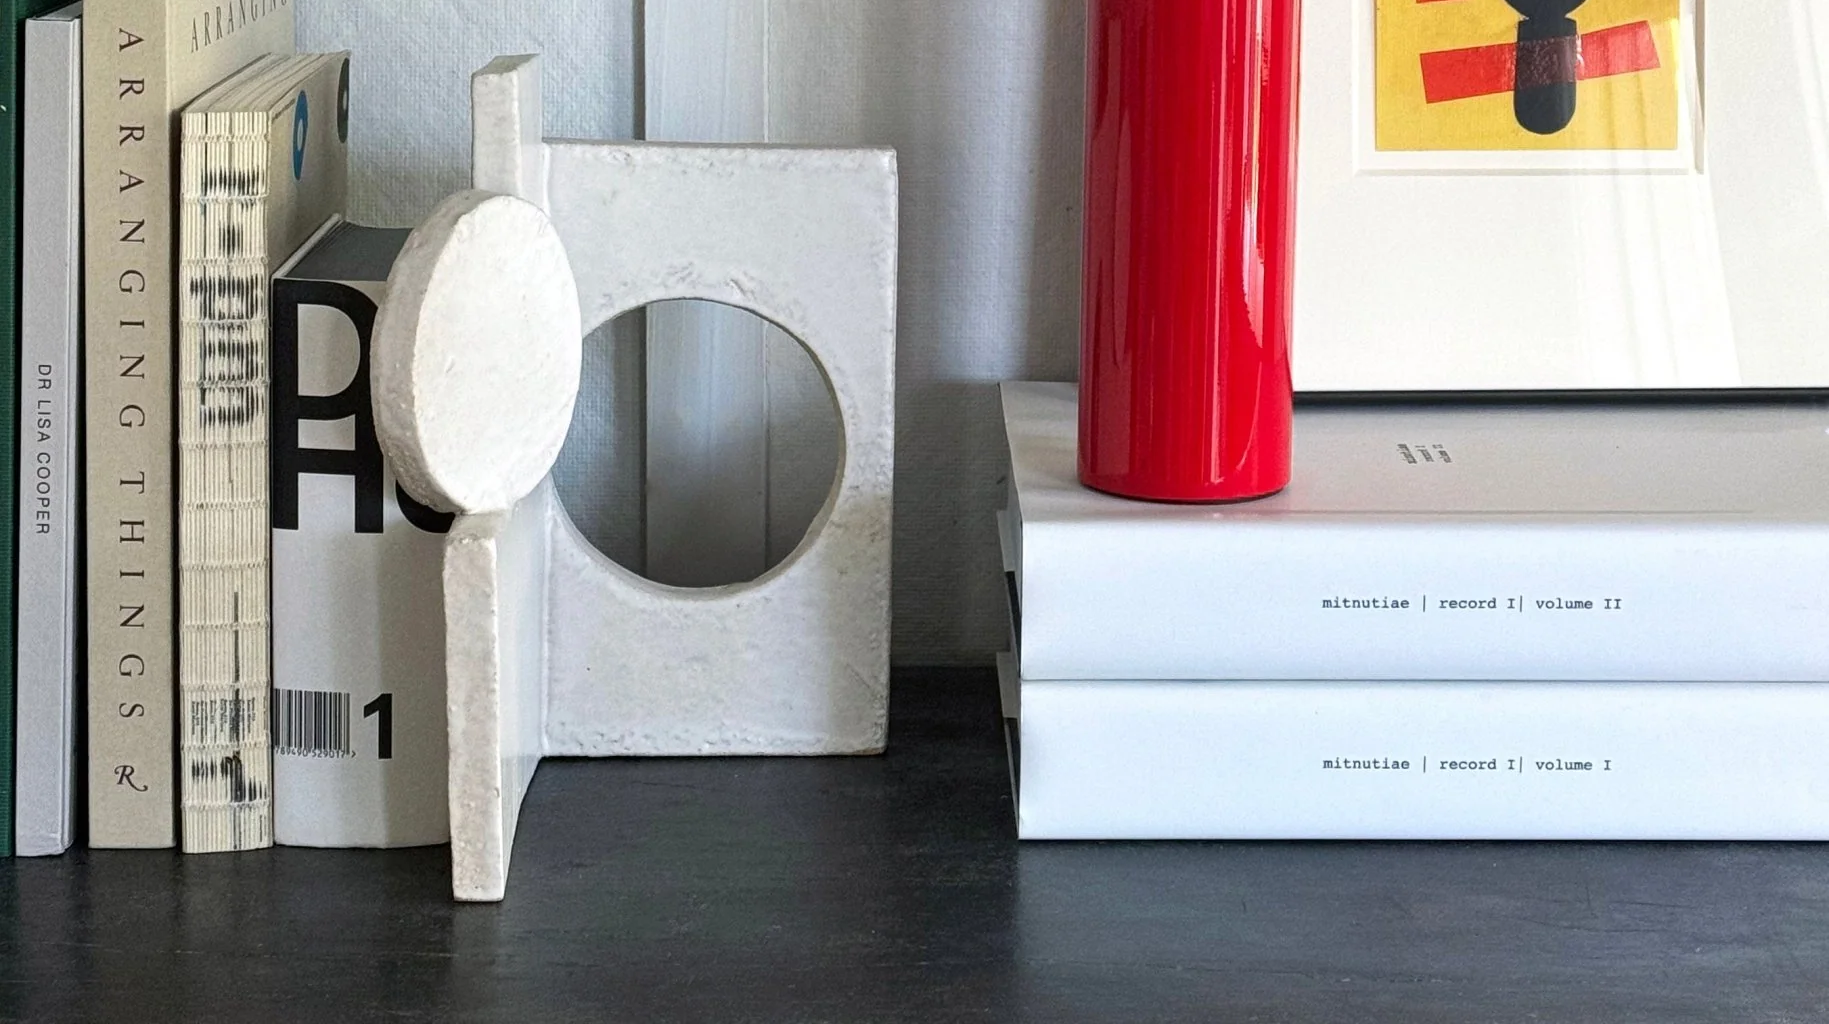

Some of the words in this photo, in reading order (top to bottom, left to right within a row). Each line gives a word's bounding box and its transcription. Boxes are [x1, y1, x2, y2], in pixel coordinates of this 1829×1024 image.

[119, 28, 145, 428] ARRANGING
[38, 364, 52, 390] DR
[37, 400, 52, 443] LISA
[36, 452, 51, 534] COOPER
[118, 471, 145, 719] THINGS
[1321, 596, 1411, 609] mitnutiae
[1439, 597, 1498, 610] record
[1535, 597, 1594, 610] volume
[1603, 598, 1623, 610] II
[363, 693, 392, 760] 1
[1321, 757, 1411, 770] mitnutiae
[1439, 758, 1498, 771] record
[1535, 758, 1594, 771] volume
[1603, 759, 1612, 771] I
